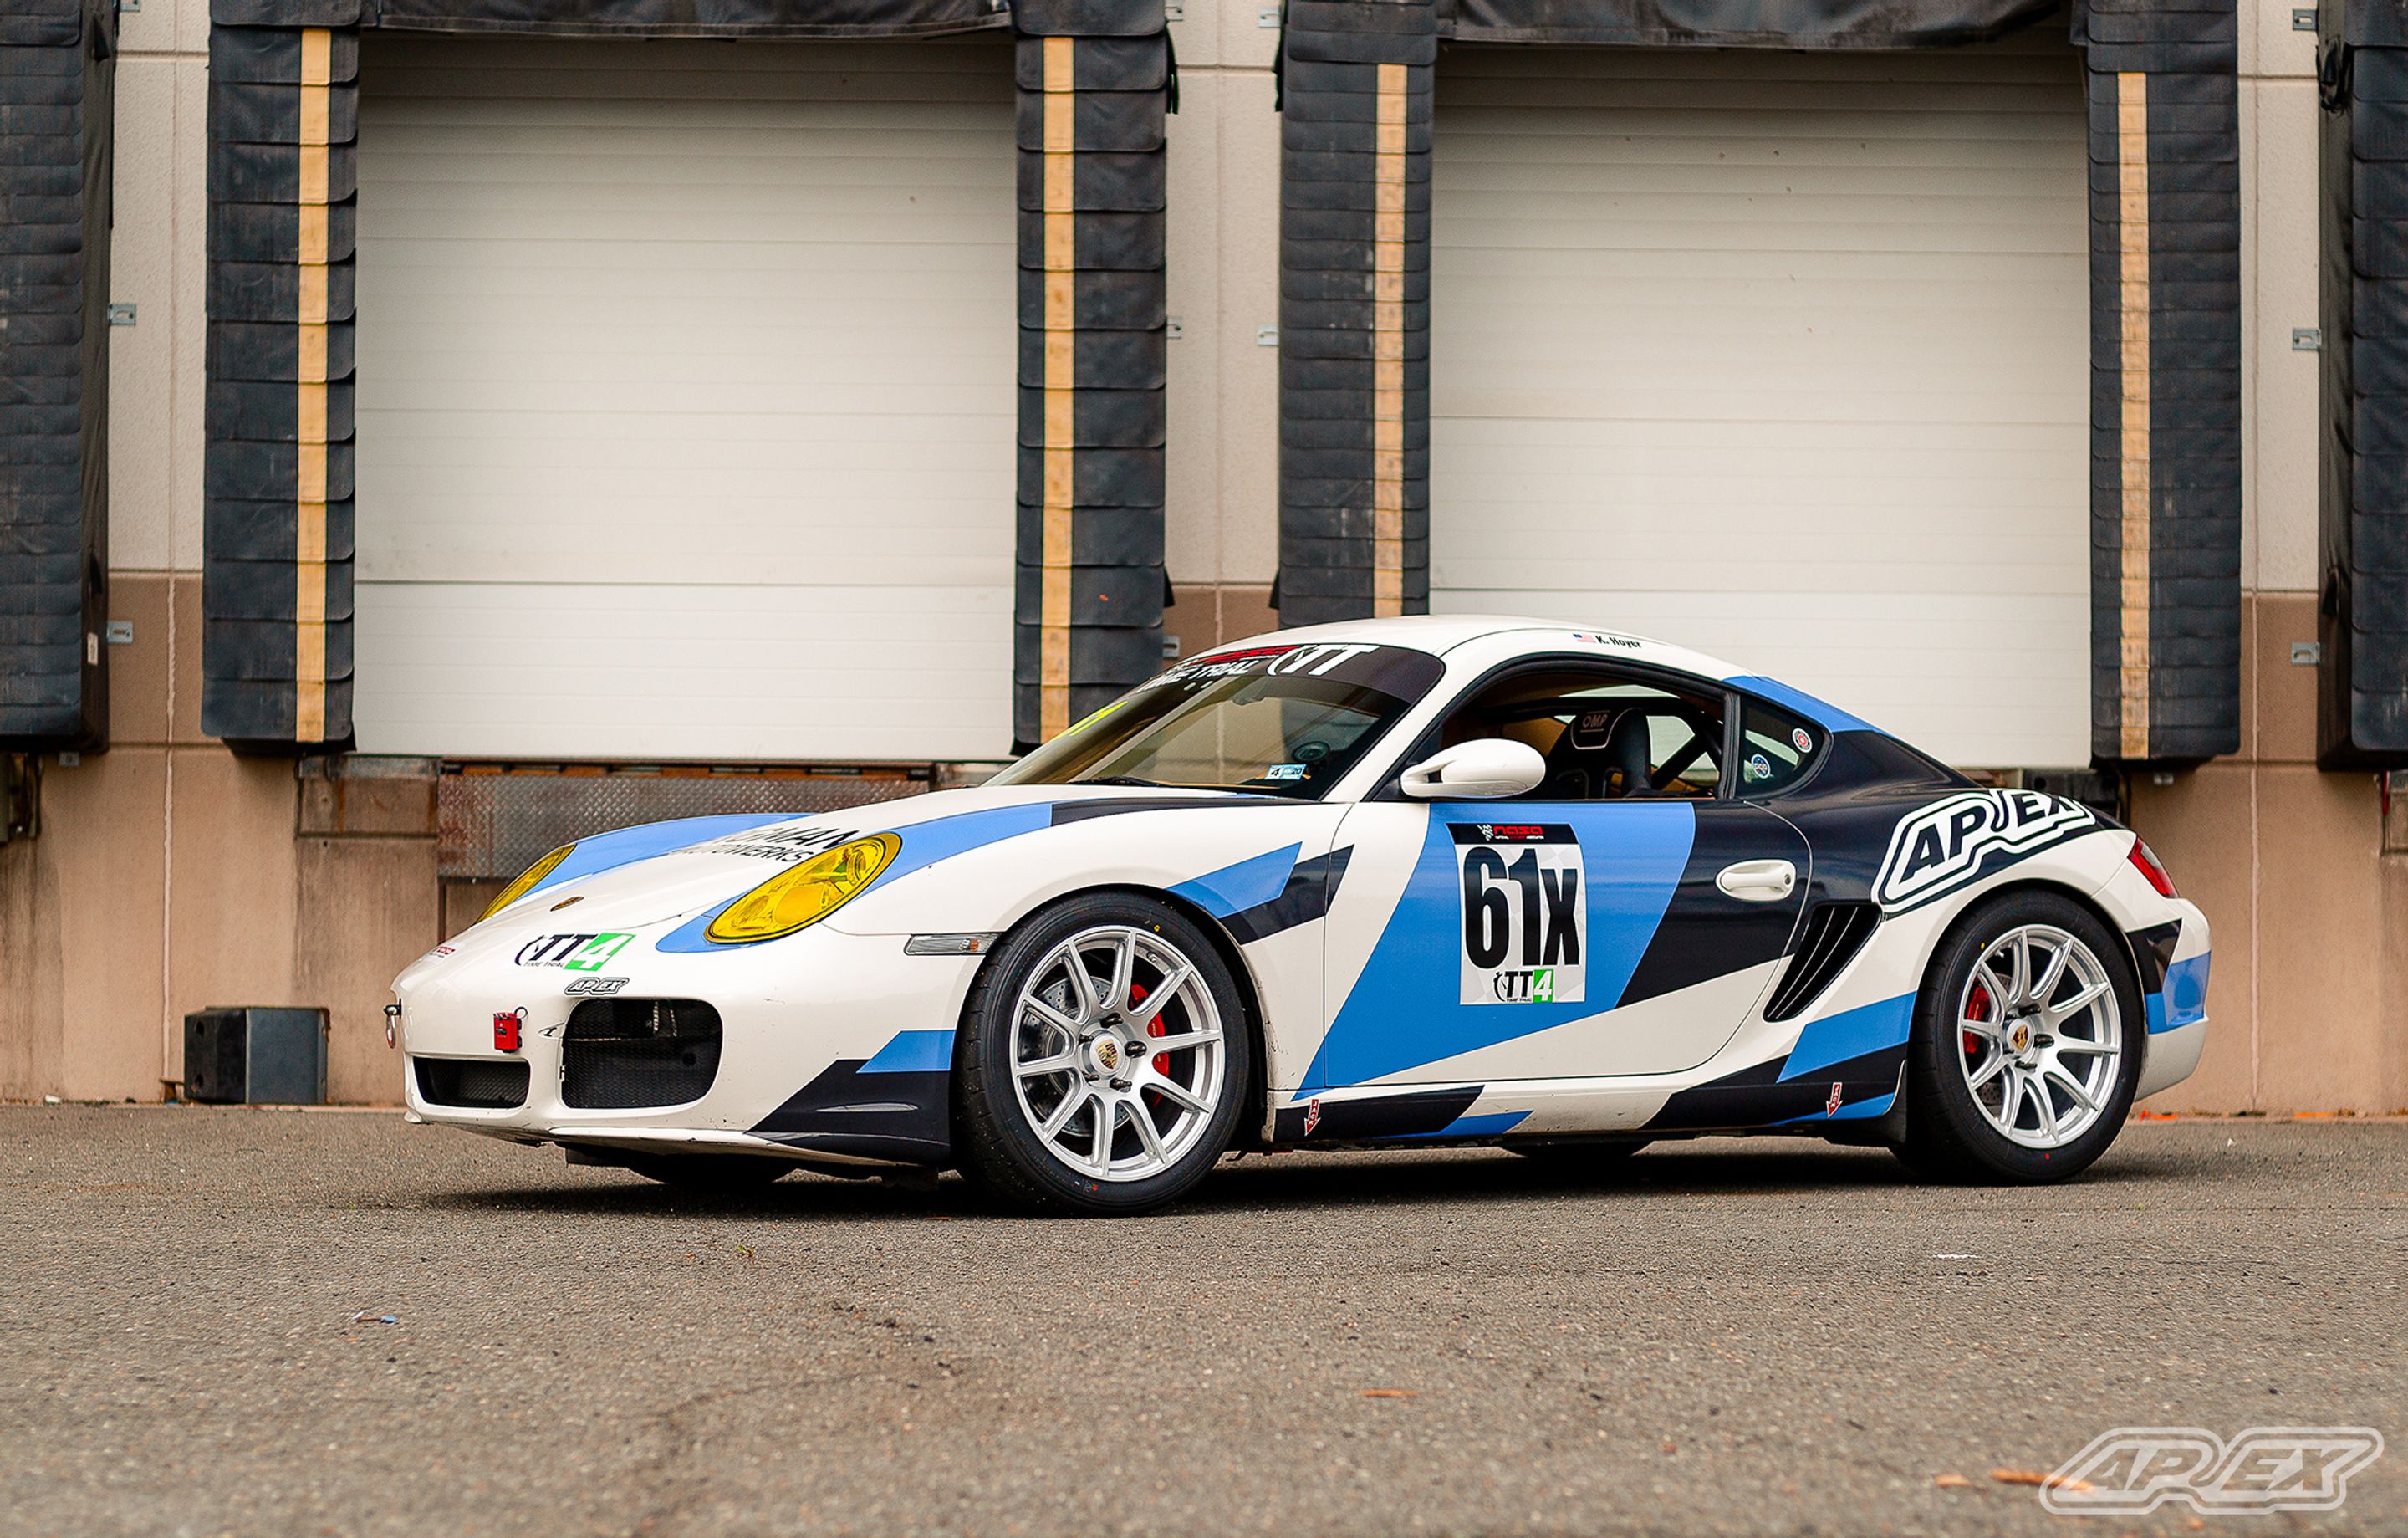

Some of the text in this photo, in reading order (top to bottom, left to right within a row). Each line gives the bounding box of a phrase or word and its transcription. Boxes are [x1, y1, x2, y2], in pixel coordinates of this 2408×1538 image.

[1610, 636, 1641, 648] Hoyer
[1582, 714, 1609, 728] OMP
[567, 979, 627, 993] APEX
